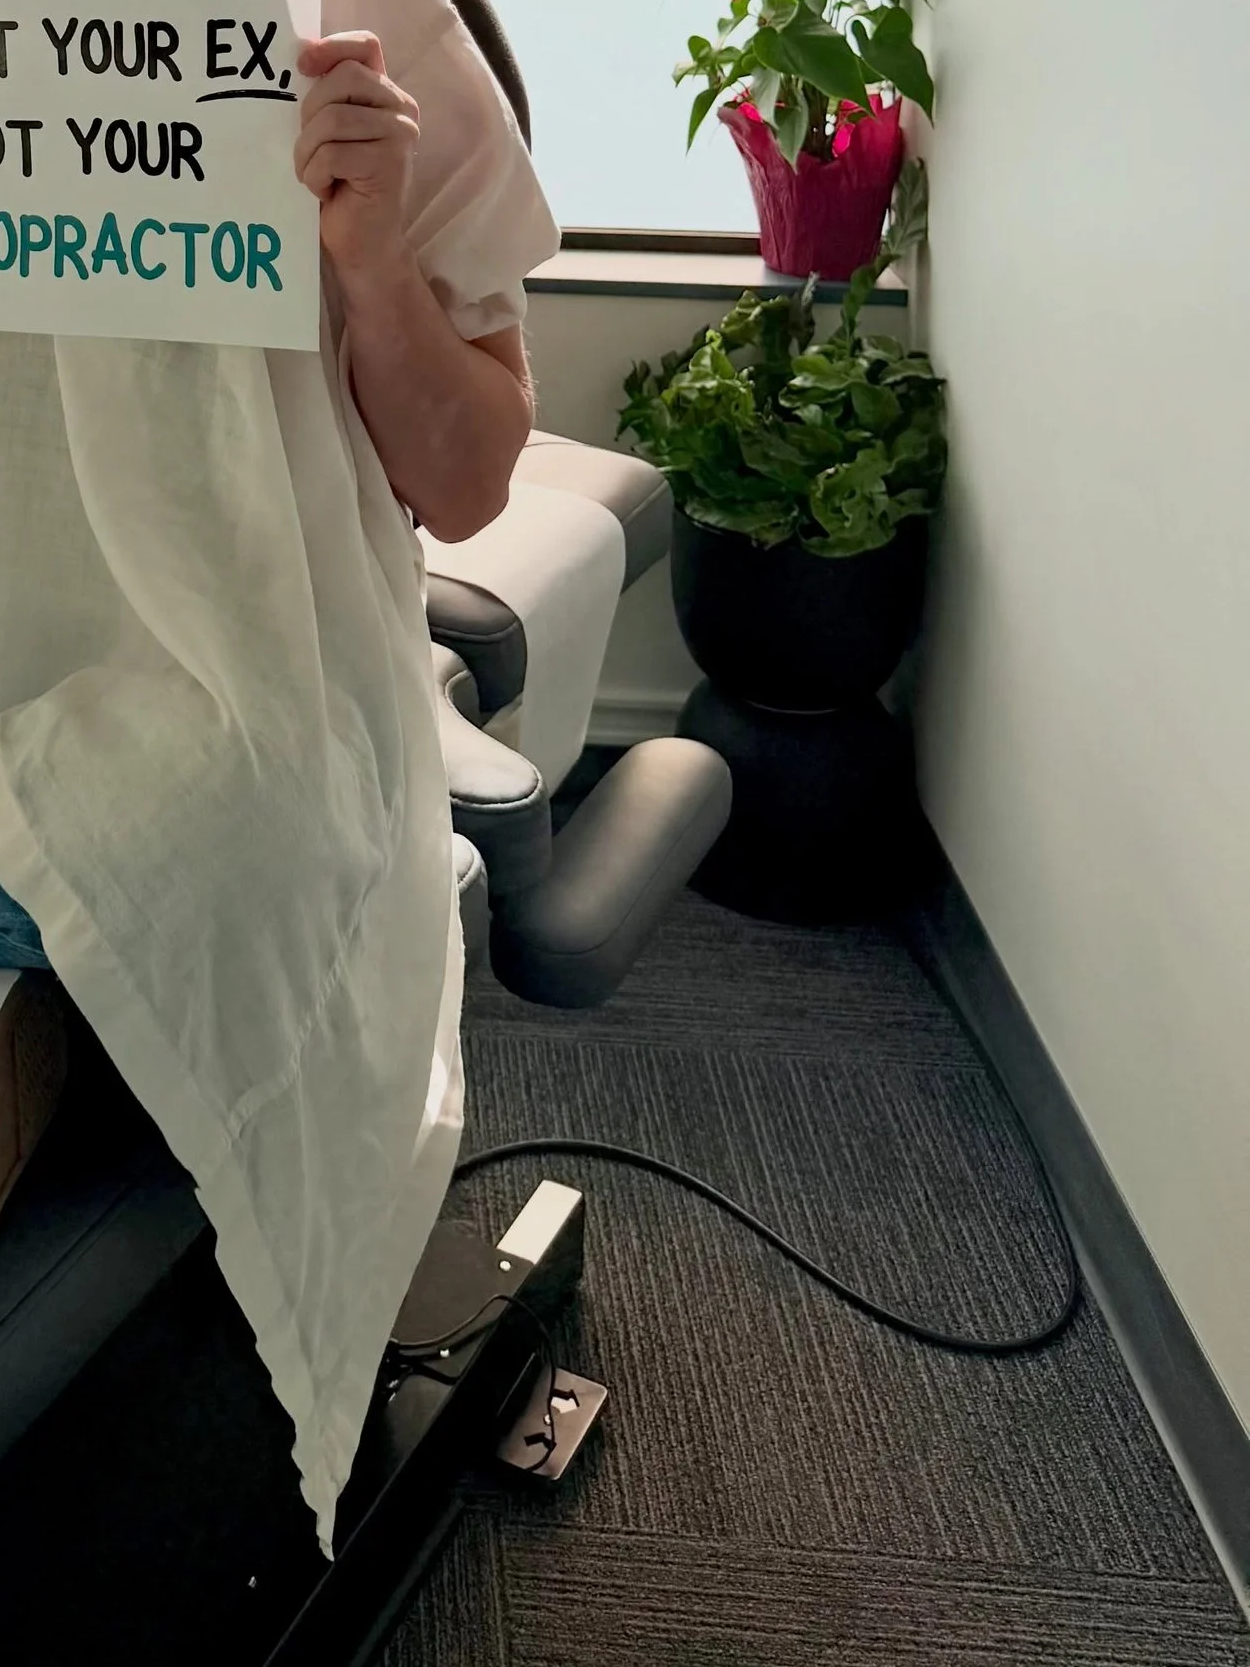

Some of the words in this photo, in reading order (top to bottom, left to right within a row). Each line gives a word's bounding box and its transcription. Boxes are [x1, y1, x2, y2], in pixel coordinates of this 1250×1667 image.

[42, 17, 182, 82] YOUR
[206, 18, 292, 90] EX,
[66, 118, 205, 181] YOUR
